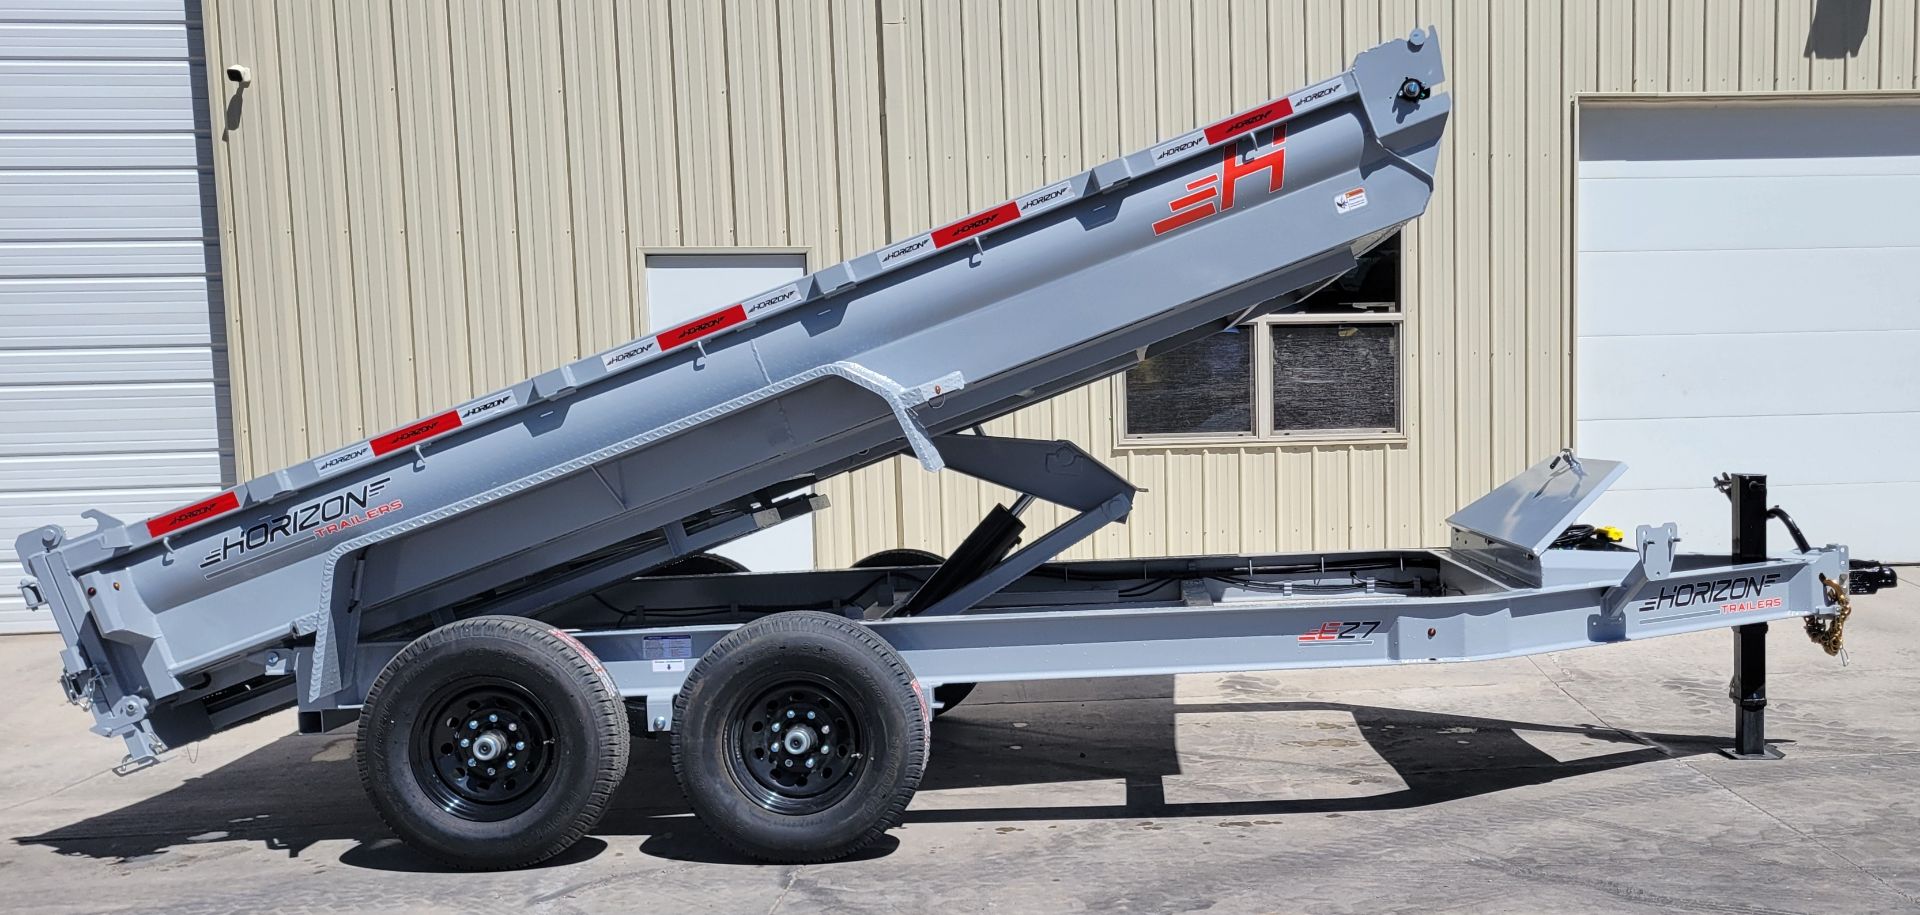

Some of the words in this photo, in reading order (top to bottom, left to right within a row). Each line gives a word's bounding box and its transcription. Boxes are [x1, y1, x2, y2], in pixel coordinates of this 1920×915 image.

[1299, 86, 1336, 105] HORIZON
[1162, 138, 1199, 158] HORIZON
[1026, 189, 1063, 208] HORIZON
[887, 241, 925, 260] HORIZON
[752, 293, 790, 312] HORIZON
[610, 345, 649, 364] HORIZON
[467, 397, 506, 417] HORIZON
[325, 448, 364, 470] HORIZON
[222, 485, 369, 561] HORIZON
[314, 499, 403, 539] TRAILERS
[1656, 575, 1766, 610] HORIZON
[1720, 598, 1782, 614] TRAILERS
[1317, 620, 1382, 640] E27
